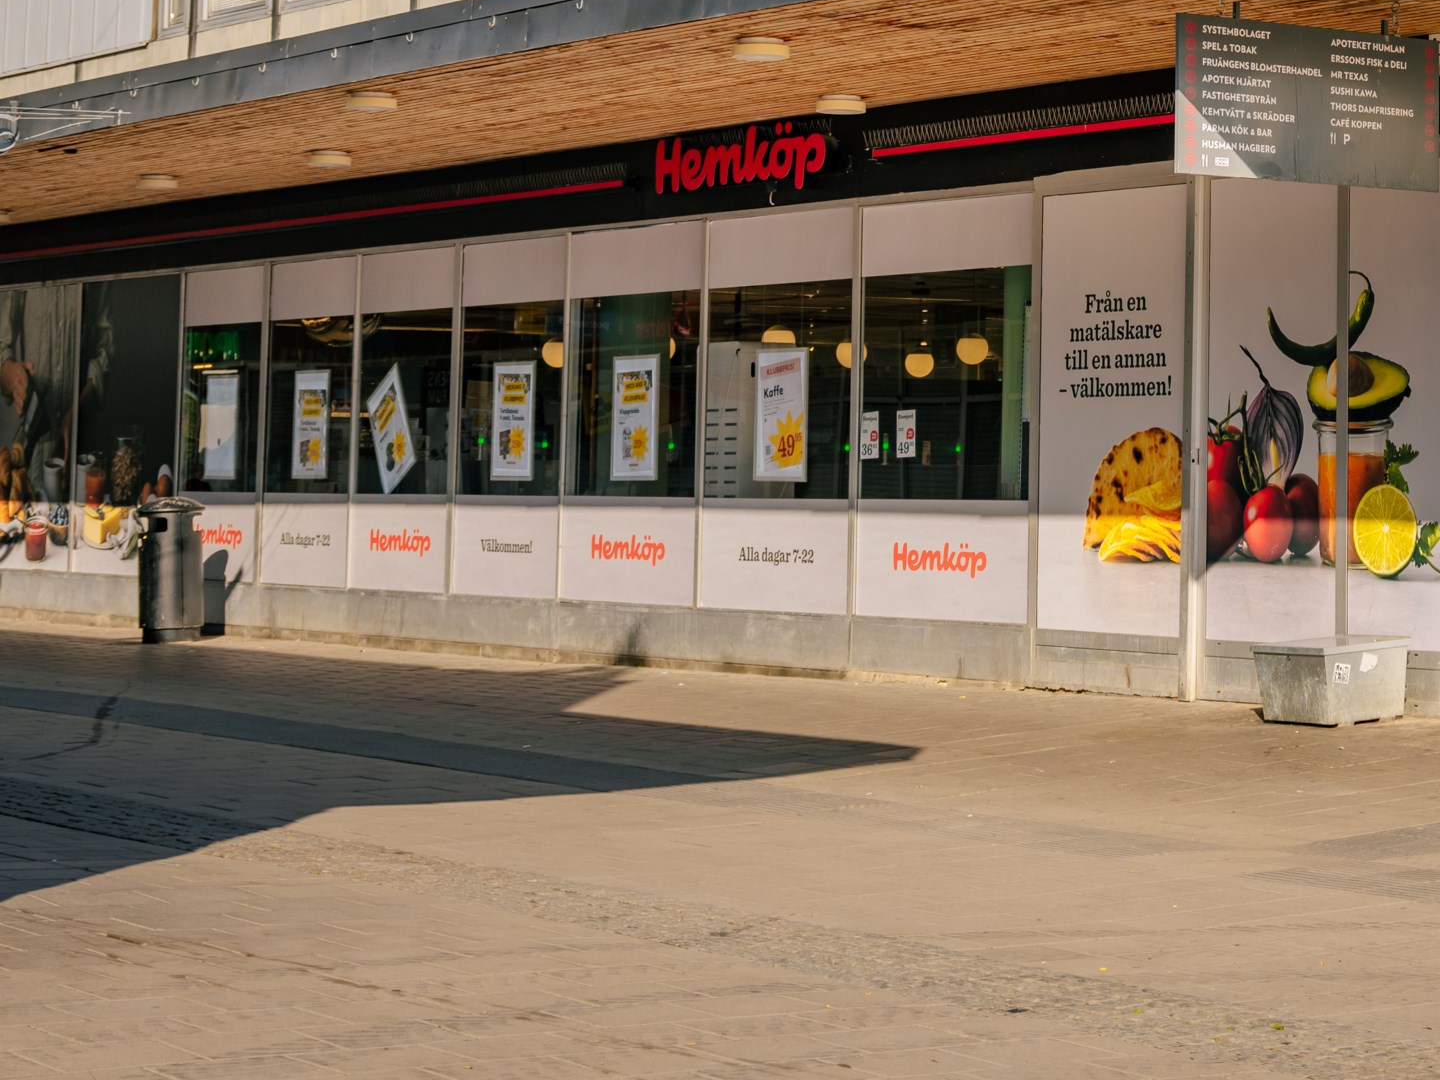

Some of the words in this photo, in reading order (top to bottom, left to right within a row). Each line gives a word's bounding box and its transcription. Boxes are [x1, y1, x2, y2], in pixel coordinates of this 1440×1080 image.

[1202, 25, 1271, 40] SYSTEMBOLAGET
[1202, 41, 1221, 51] SPEL
[1229, 43, 1258, 54] TOBAK
[1331, 39, 1372, 51] APOTEKET
[1372, 42, 1405, 54] HUMLAN
[1202, 57, 1250, 70] FRUÄNGENS
[1251, 63, 1323, 78] BLOMSTERHANDEL
[1331, 54, 1365, 66] ERSSONS
[1367, 58, 1383, 67] FISK
[1384, 60, 1389, 68] &
[1391, 60, 1407, 70] DELI
[1202, 75, 1235, 85] APOTEK
[1236, 75, 1272, 88] HJÄRTAT
[1331, 71, 1343, 79] MR
[1344, 72, 1369, 82] TEXAS
[1202, 91, 1277, 105] FASTIGHETSBYRÅN
[1330, 86, 1353, 96] SUSHI
[1354, 88, 1377, 99] KAWA
[1202, 107, 1245, 119] KEMTVÄTT
[1253, 111, 1295, 123] SKRÄDDER
[1330, 102, 1357, 112] THORS
[1358, 104, 1414, 118] DAMFRISERING
[1202, 123, 1230, 134] PARMA
[1231, 124, 1248, 135] KÖK
[1250, 128, 1255, 136] &
[1257, 127, 1272, 137] BAR
[1330, 118, 1350, 127] CAFÉ
[1351, 120, 1382, 130] KOPPEN
[1202, 140, 1238, 151] HUSMAN
[1239, 142, 1276, 154] HAGBERG
[655, 121, 827, 195] Hemköp
[1085, 290, 1123, 314] Från
[1127, 296, 1147, 311] en
[1069, 319, 1162, 342] matälskare
[1064, 349, 1088, 371] till
[1091, 355, 1111, 369] en
[1115, 351, 1167, 369] annan
[766, 362, 795, 376] KLUBBPRIS!
[763, 384, 784, 399] Kaffe
[1070, 375, 1172, 398] välkommen!
[778, 434, 795, 458] 49
[861, 443, 873, 456] 36
[898, 441, 910, 454] 49
[280, 532, 295, 545] Alla
[295, 534, 316, 549] dagar
[316, 534, 331, 547] 7-22
[369, 528, 431, 557] Hemköp
[480, 538, 533, 554] Välkommen!
[590, 534, 666, 567] Hemköp
[738, 546, 760, 563] Alla
[761, 547, 791, 566] dagar
[792, 549, 815, 564] 7-22
[892, 541, 988, 579] Hemköp
